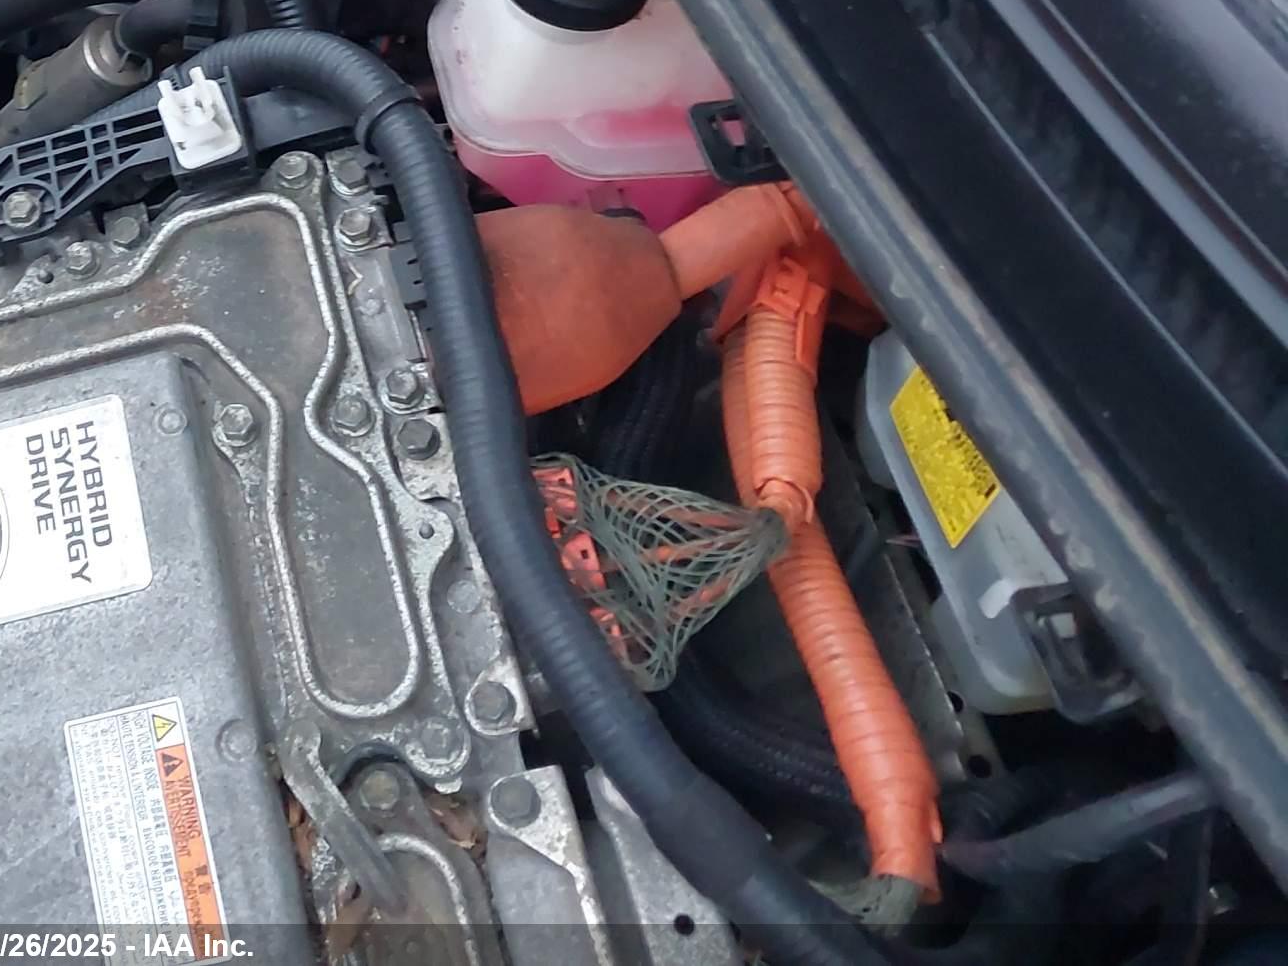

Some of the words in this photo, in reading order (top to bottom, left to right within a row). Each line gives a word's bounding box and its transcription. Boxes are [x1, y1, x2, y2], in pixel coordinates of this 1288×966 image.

[26, 434, 56, 534] DRIVE
[50, 427, 91, 583] SYNERGY
[76, 420, 112, 547] HYBRID
[175, 775, 200, 839] WARNING
